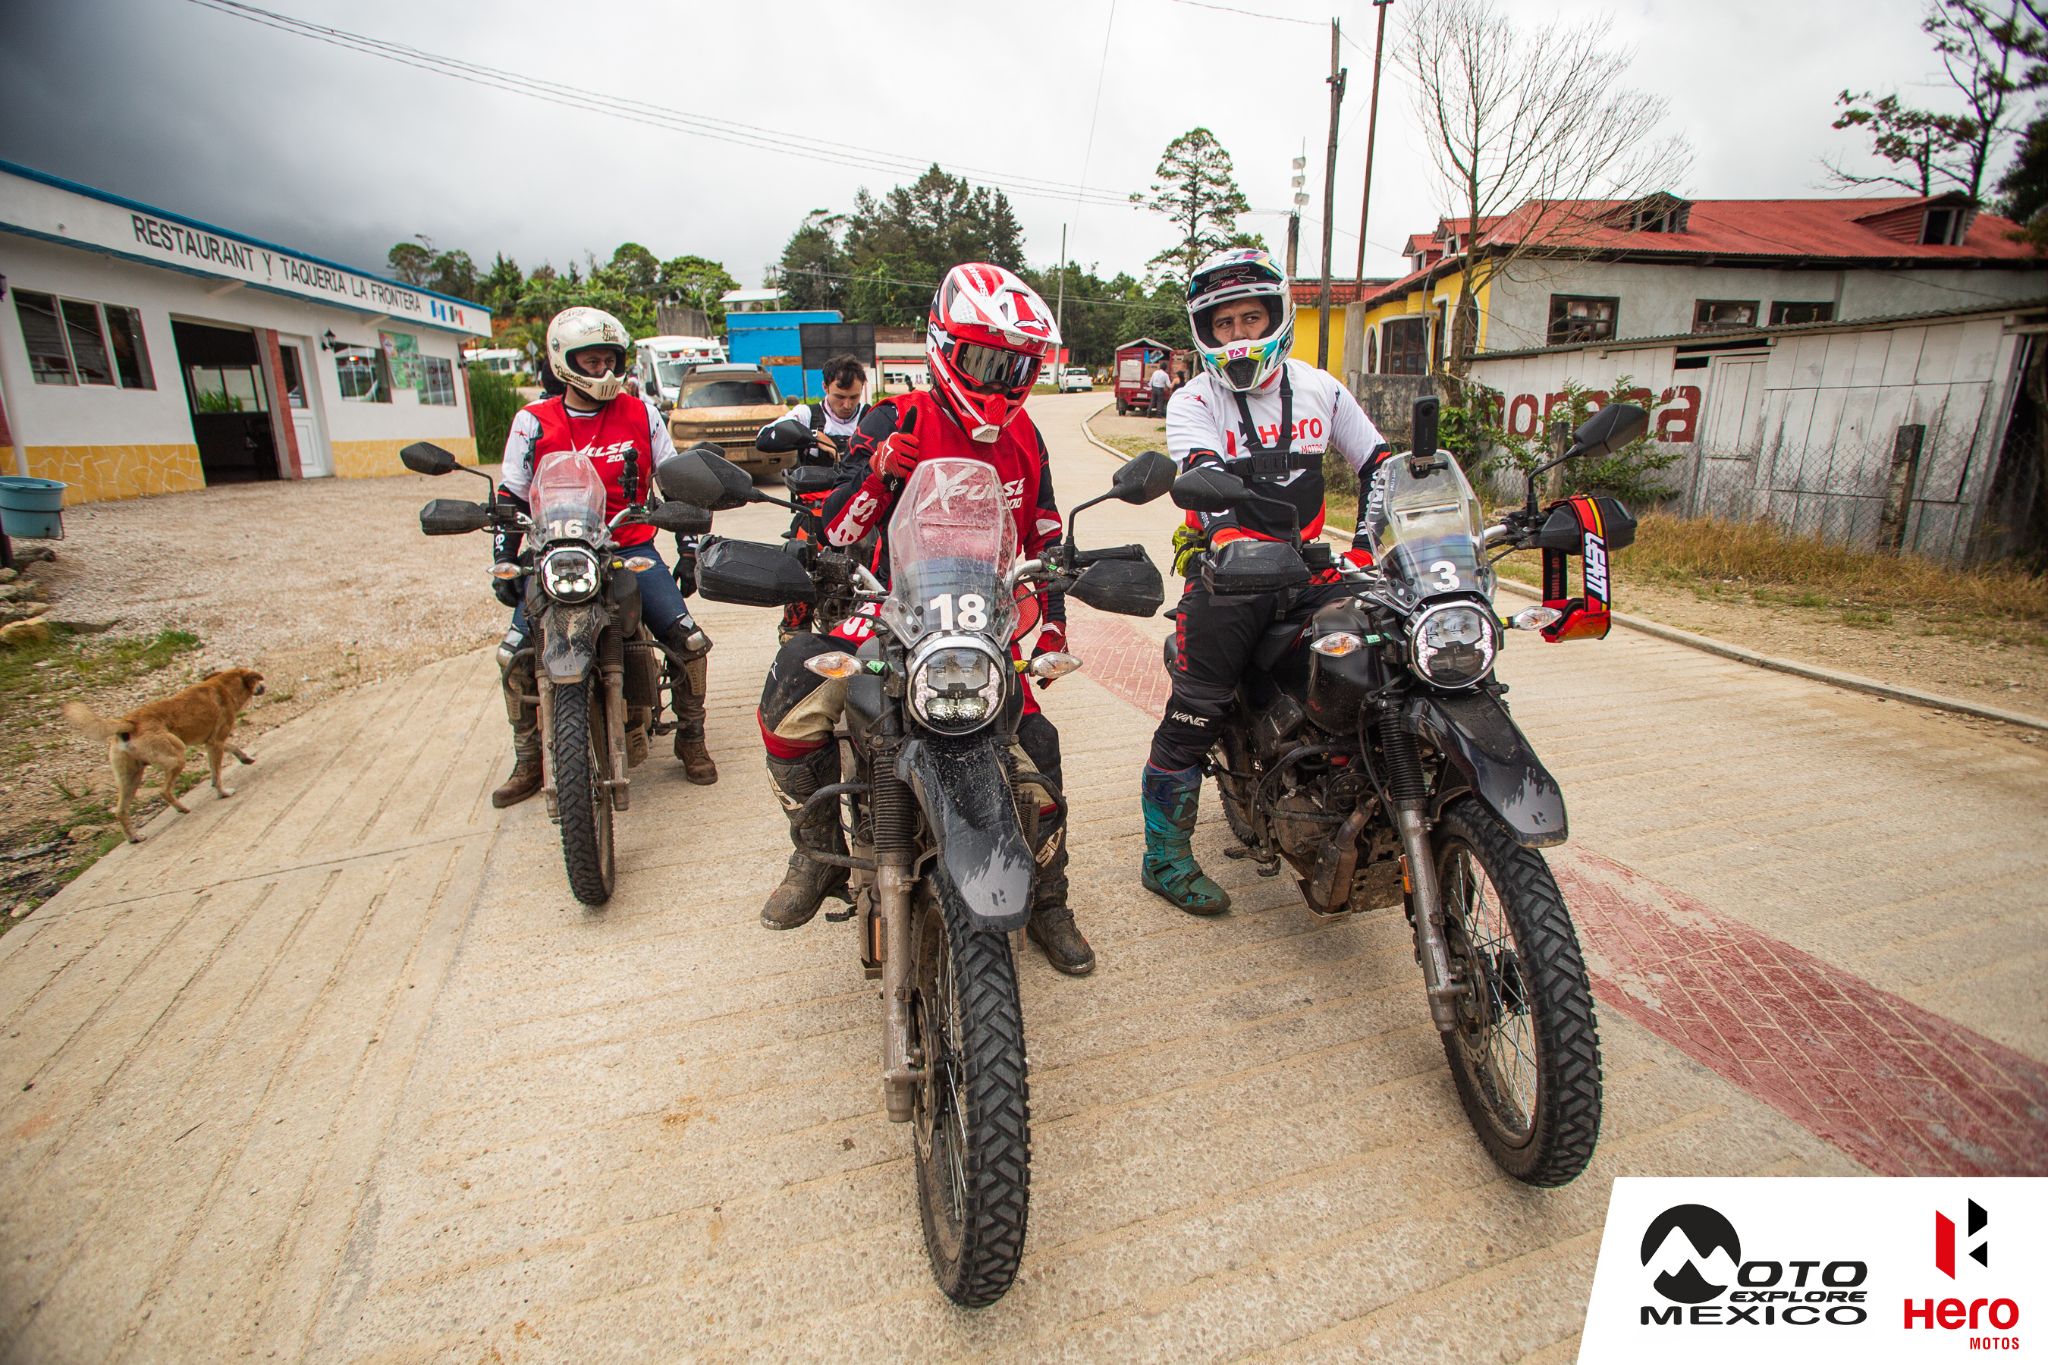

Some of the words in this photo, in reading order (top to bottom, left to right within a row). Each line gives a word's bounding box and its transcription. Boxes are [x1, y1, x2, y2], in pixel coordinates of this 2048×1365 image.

[131, 214, 253, 271] RESTAURANT
[263, 252, 272, 276] Y
[280, 258, 347, 294] TAQUERIA
[350, 277, 368, 300] LA
[371, 283, 422, 312] FRONTERA
[606, 453, 625, 463] 20
[549, 519, 583, 538] 16
[1429, 560, 1460, 592] 3
[1584, 531, 1608, 603] LEATT
[930, 593, 988, 631] 18
